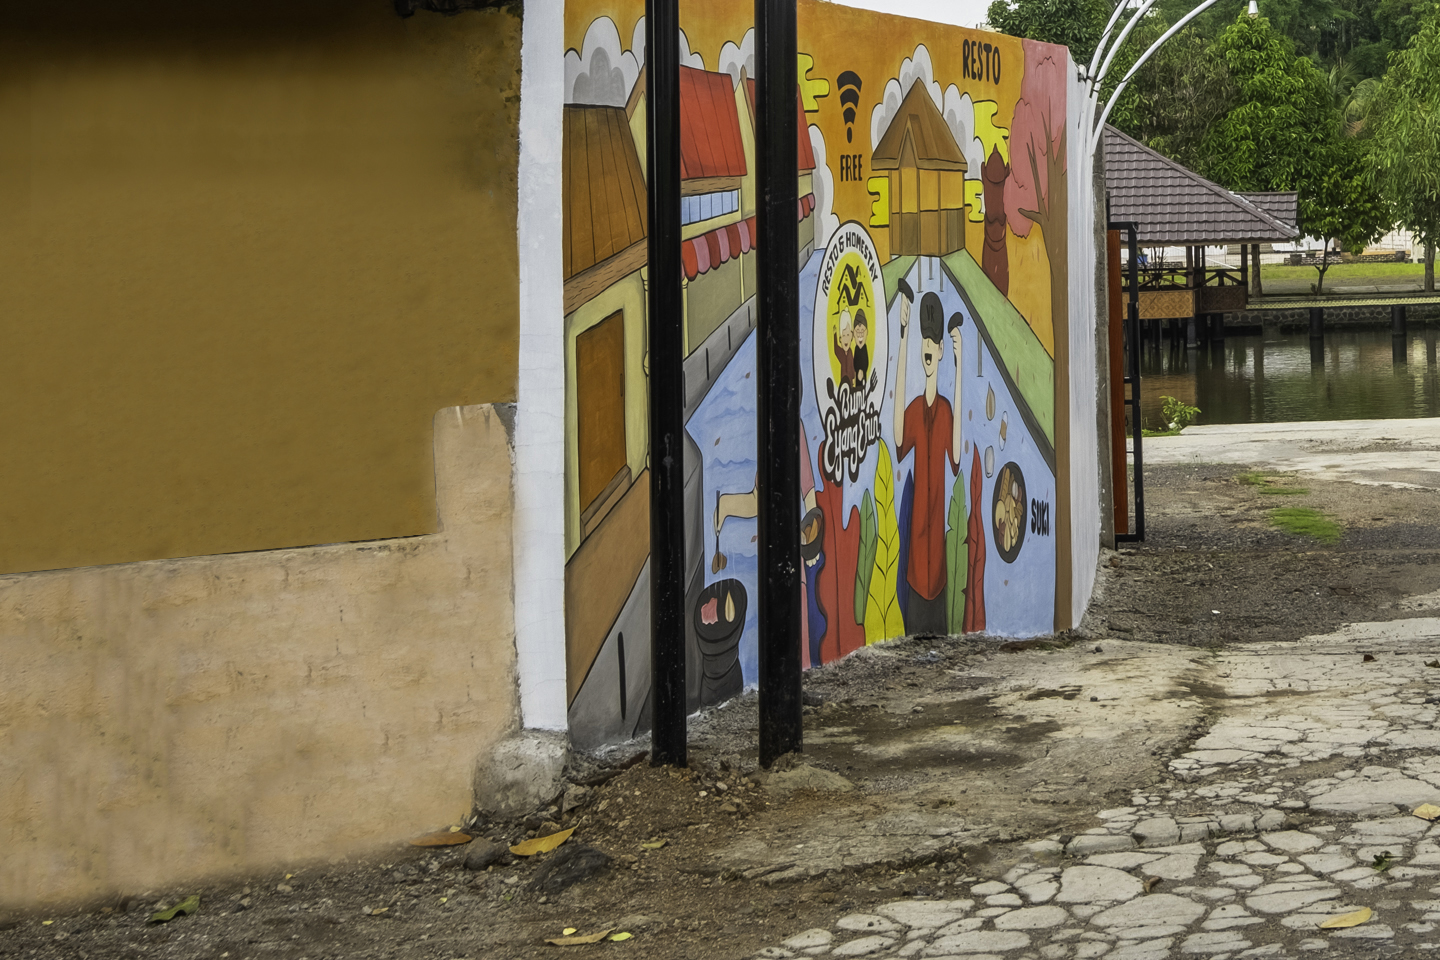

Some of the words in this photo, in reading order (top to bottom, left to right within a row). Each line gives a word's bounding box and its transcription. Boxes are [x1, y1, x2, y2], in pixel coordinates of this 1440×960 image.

[962, 38, 1001, 86] RESTO
[840, 153, 863, 182] FREE
[821, 243, 839, 297] RESTO
[838, 238, 845, 253] &
[845, 231, 879, 283] HOMESTAY
[839, 379, 867, 418] Bumi
[823, 412, 859, 476] Eyang
[858, 405, 880, 453] Enin
[1031, 497, 1049, 537] SUKI
